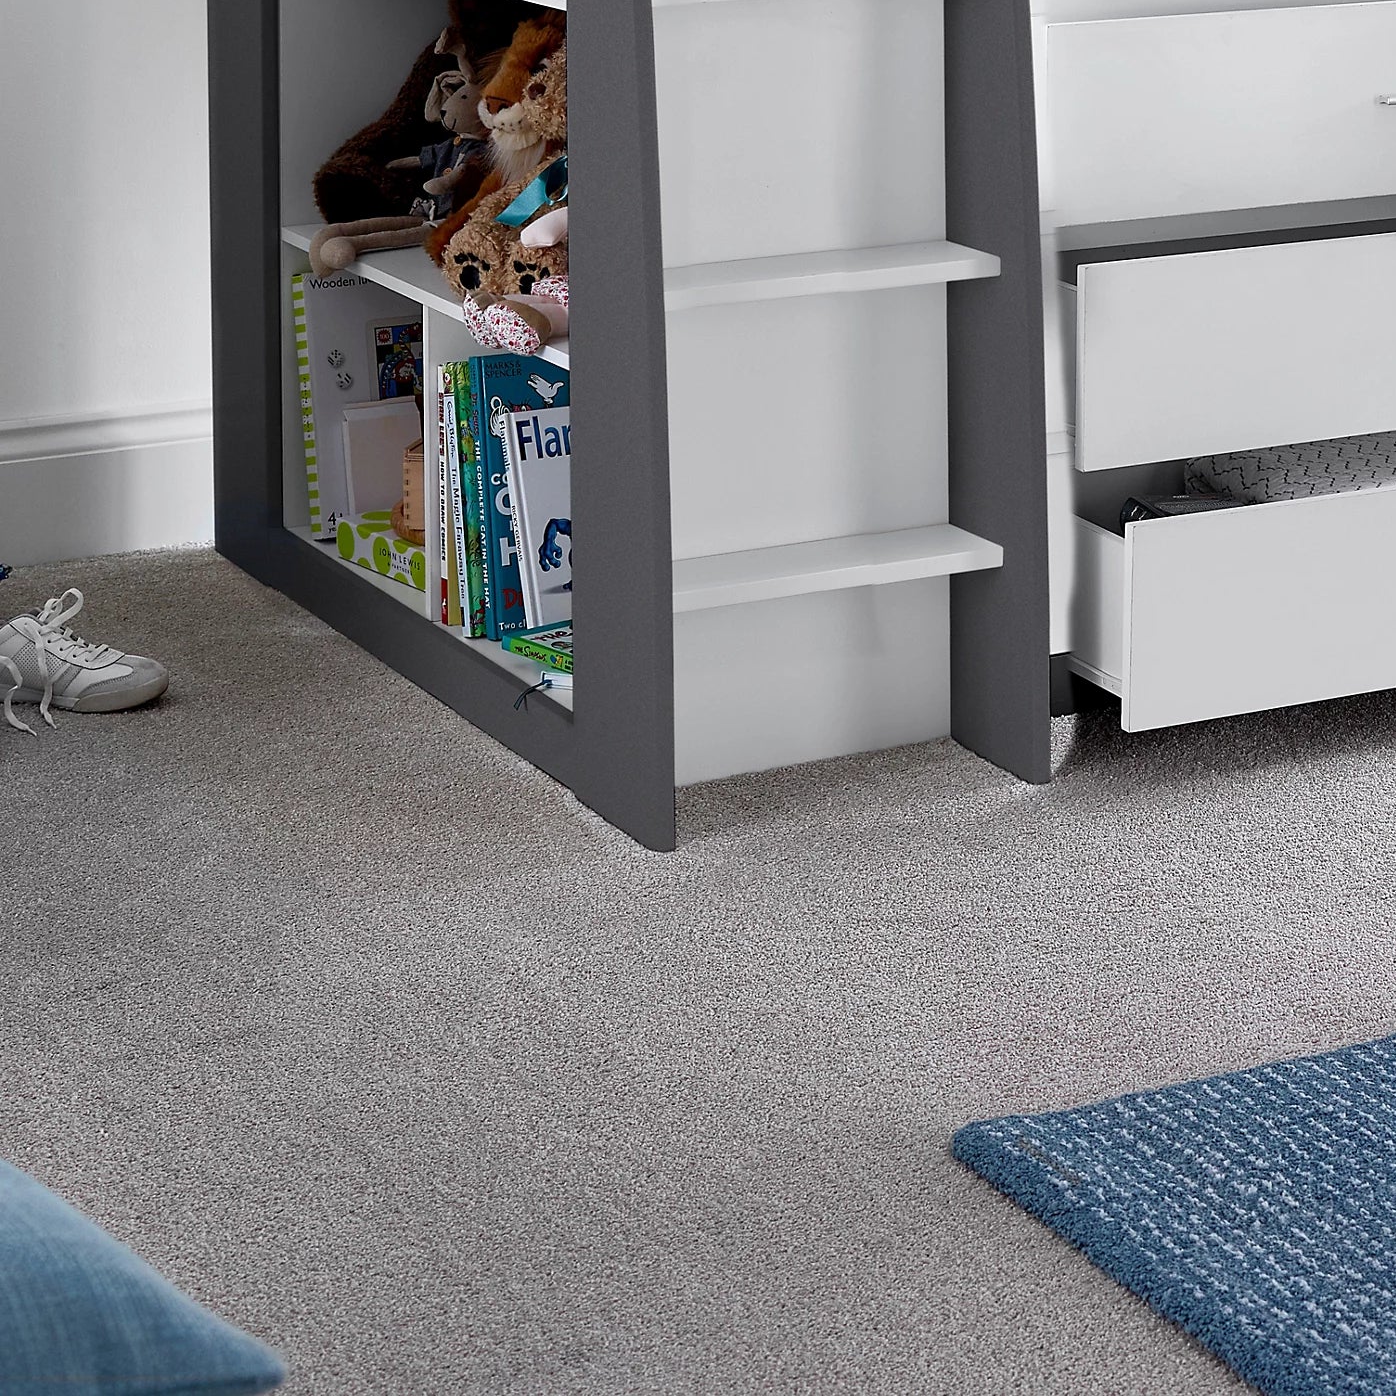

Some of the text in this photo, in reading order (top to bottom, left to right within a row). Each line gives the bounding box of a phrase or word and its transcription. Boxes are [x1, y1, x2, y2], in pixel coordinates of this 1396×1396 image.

[310, 276, 355, 290] Wooden
[485, 360, 516, 372] MARKS
[485, 368, 522, 379] SPENCER
[440, 485, 445, 496] TO
[452, 487, 460, 523] Magic
[476, 465, 485, 521] COMPLETE
[481, 547, 487, 560] IN
[511, 505, 523, 562] RICKY GERVAIS
[379, 548, 421, 571] JOHN LEWIS
[455, 526, 464, 576] Faraway
[498, 621, 516, 631] Two
